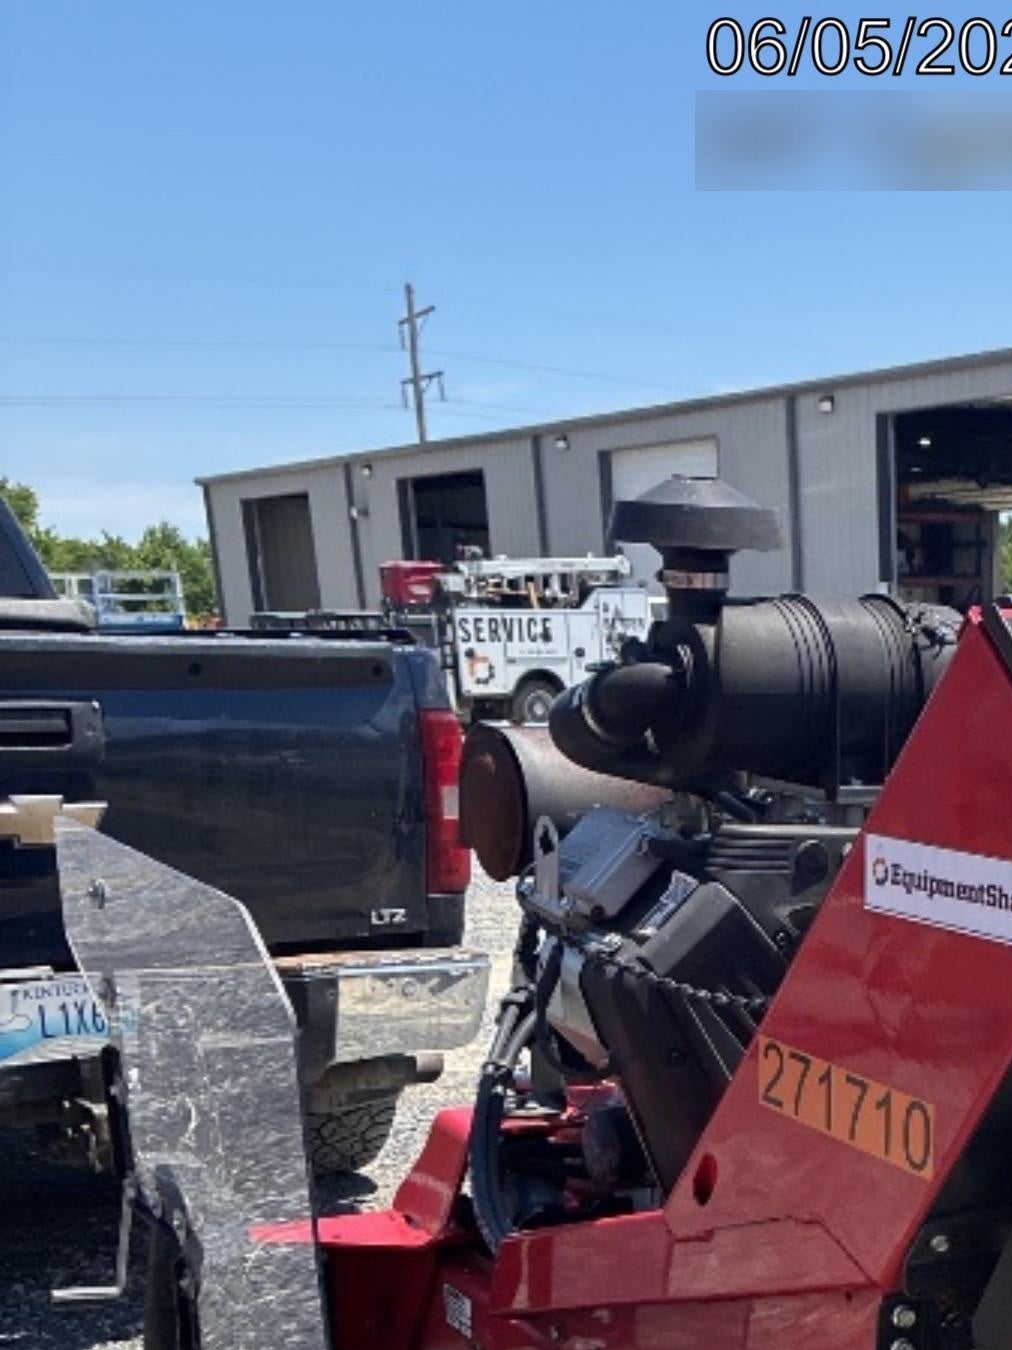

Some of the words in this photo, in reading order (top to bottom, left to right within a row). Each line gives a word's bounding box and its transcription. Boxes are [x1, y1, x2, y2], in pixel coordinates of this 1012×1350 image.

[458, 617, 553, 644] SERVICE
[371, 908, 406, 925] LTZ
[762, 1042, 931, 1173] 271710
